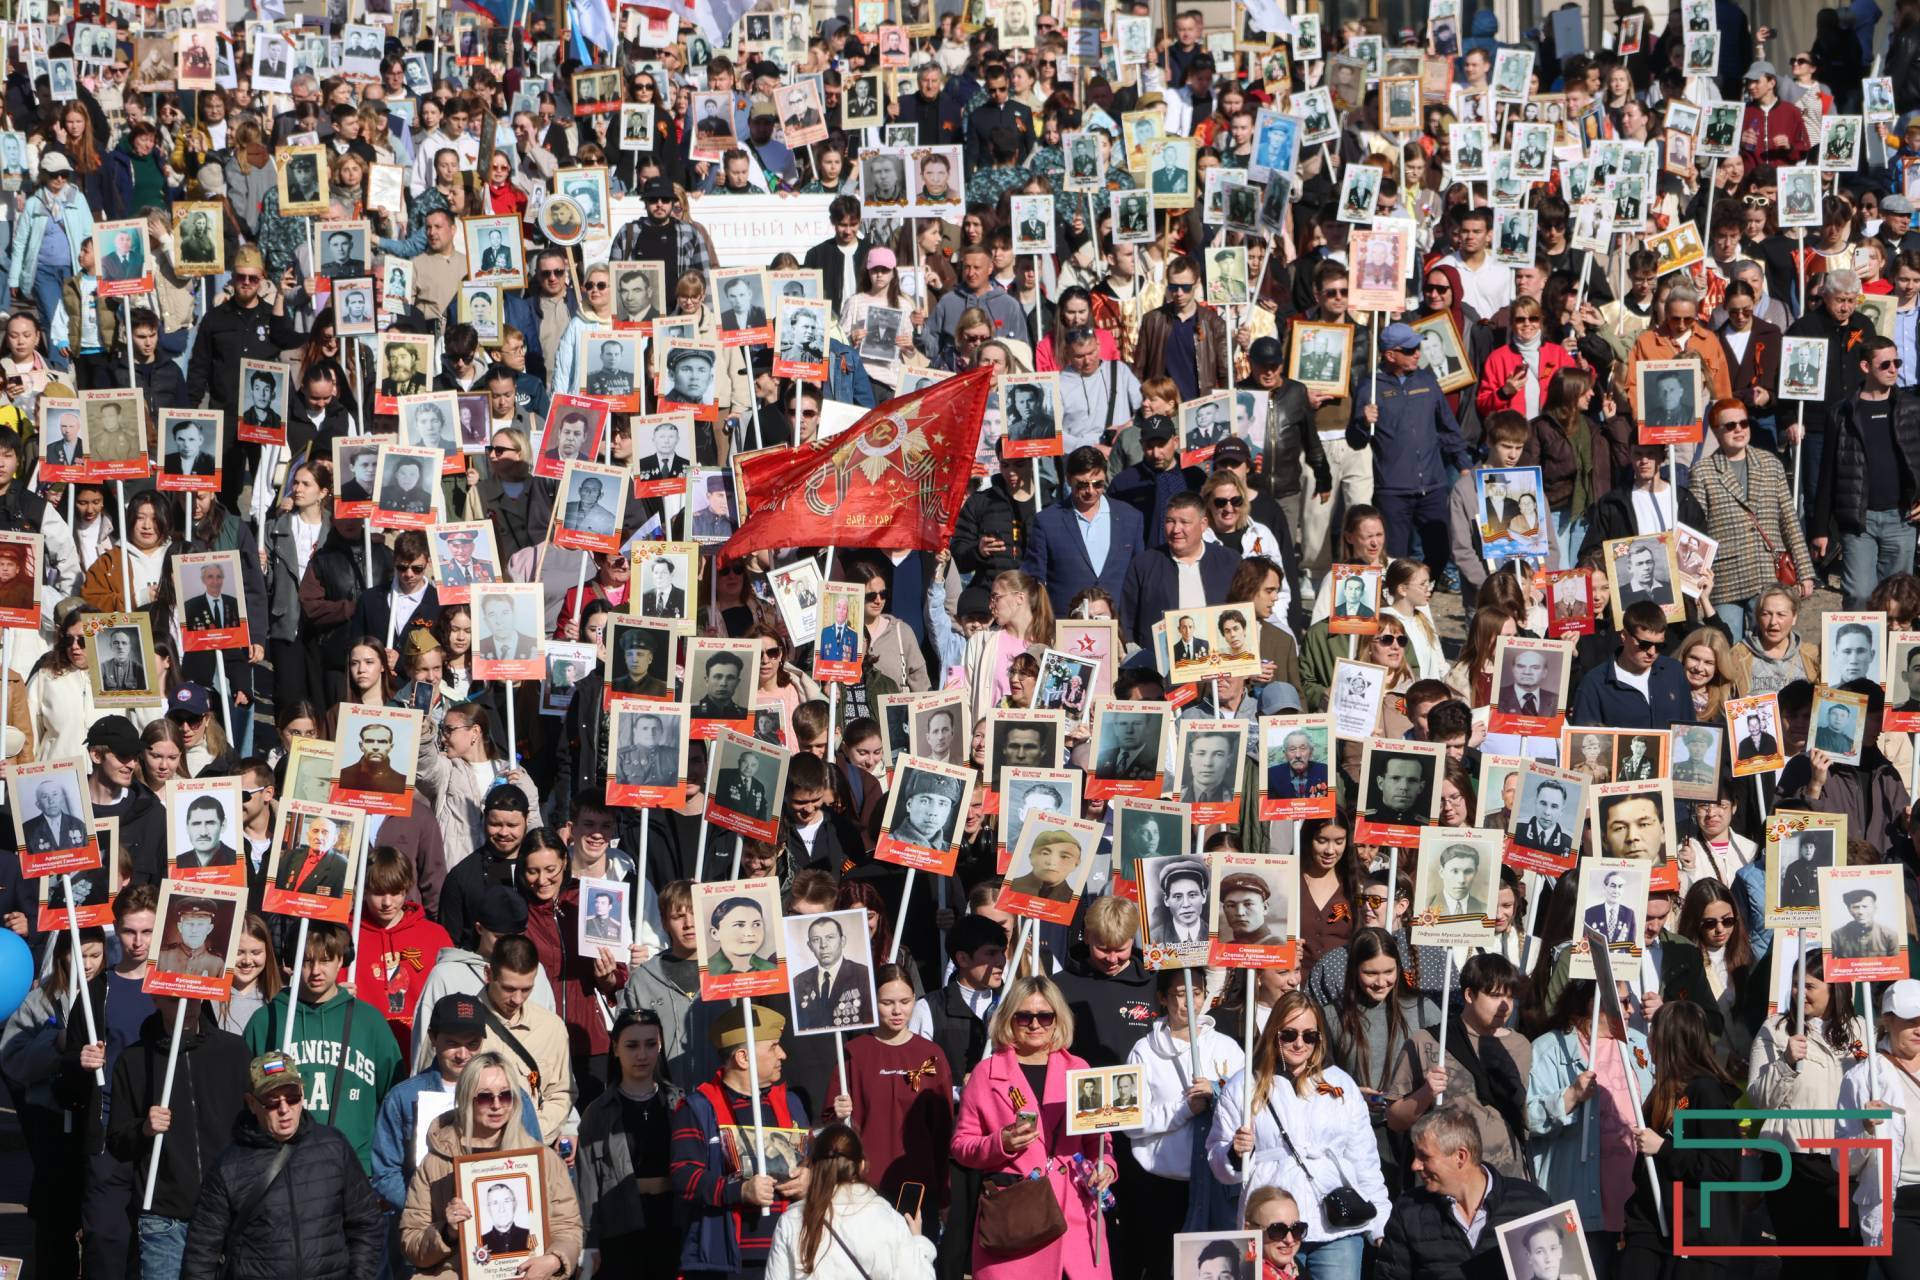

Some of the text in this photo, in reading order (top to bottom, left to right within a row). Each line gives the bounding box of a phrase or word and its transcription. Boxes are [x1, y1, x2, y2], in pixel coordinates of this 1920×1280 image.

[289, 1039, 376, 1087] ANGELES
[301, 1070, 331, 1111] A
[349, 1088, 361, 1101] 81
